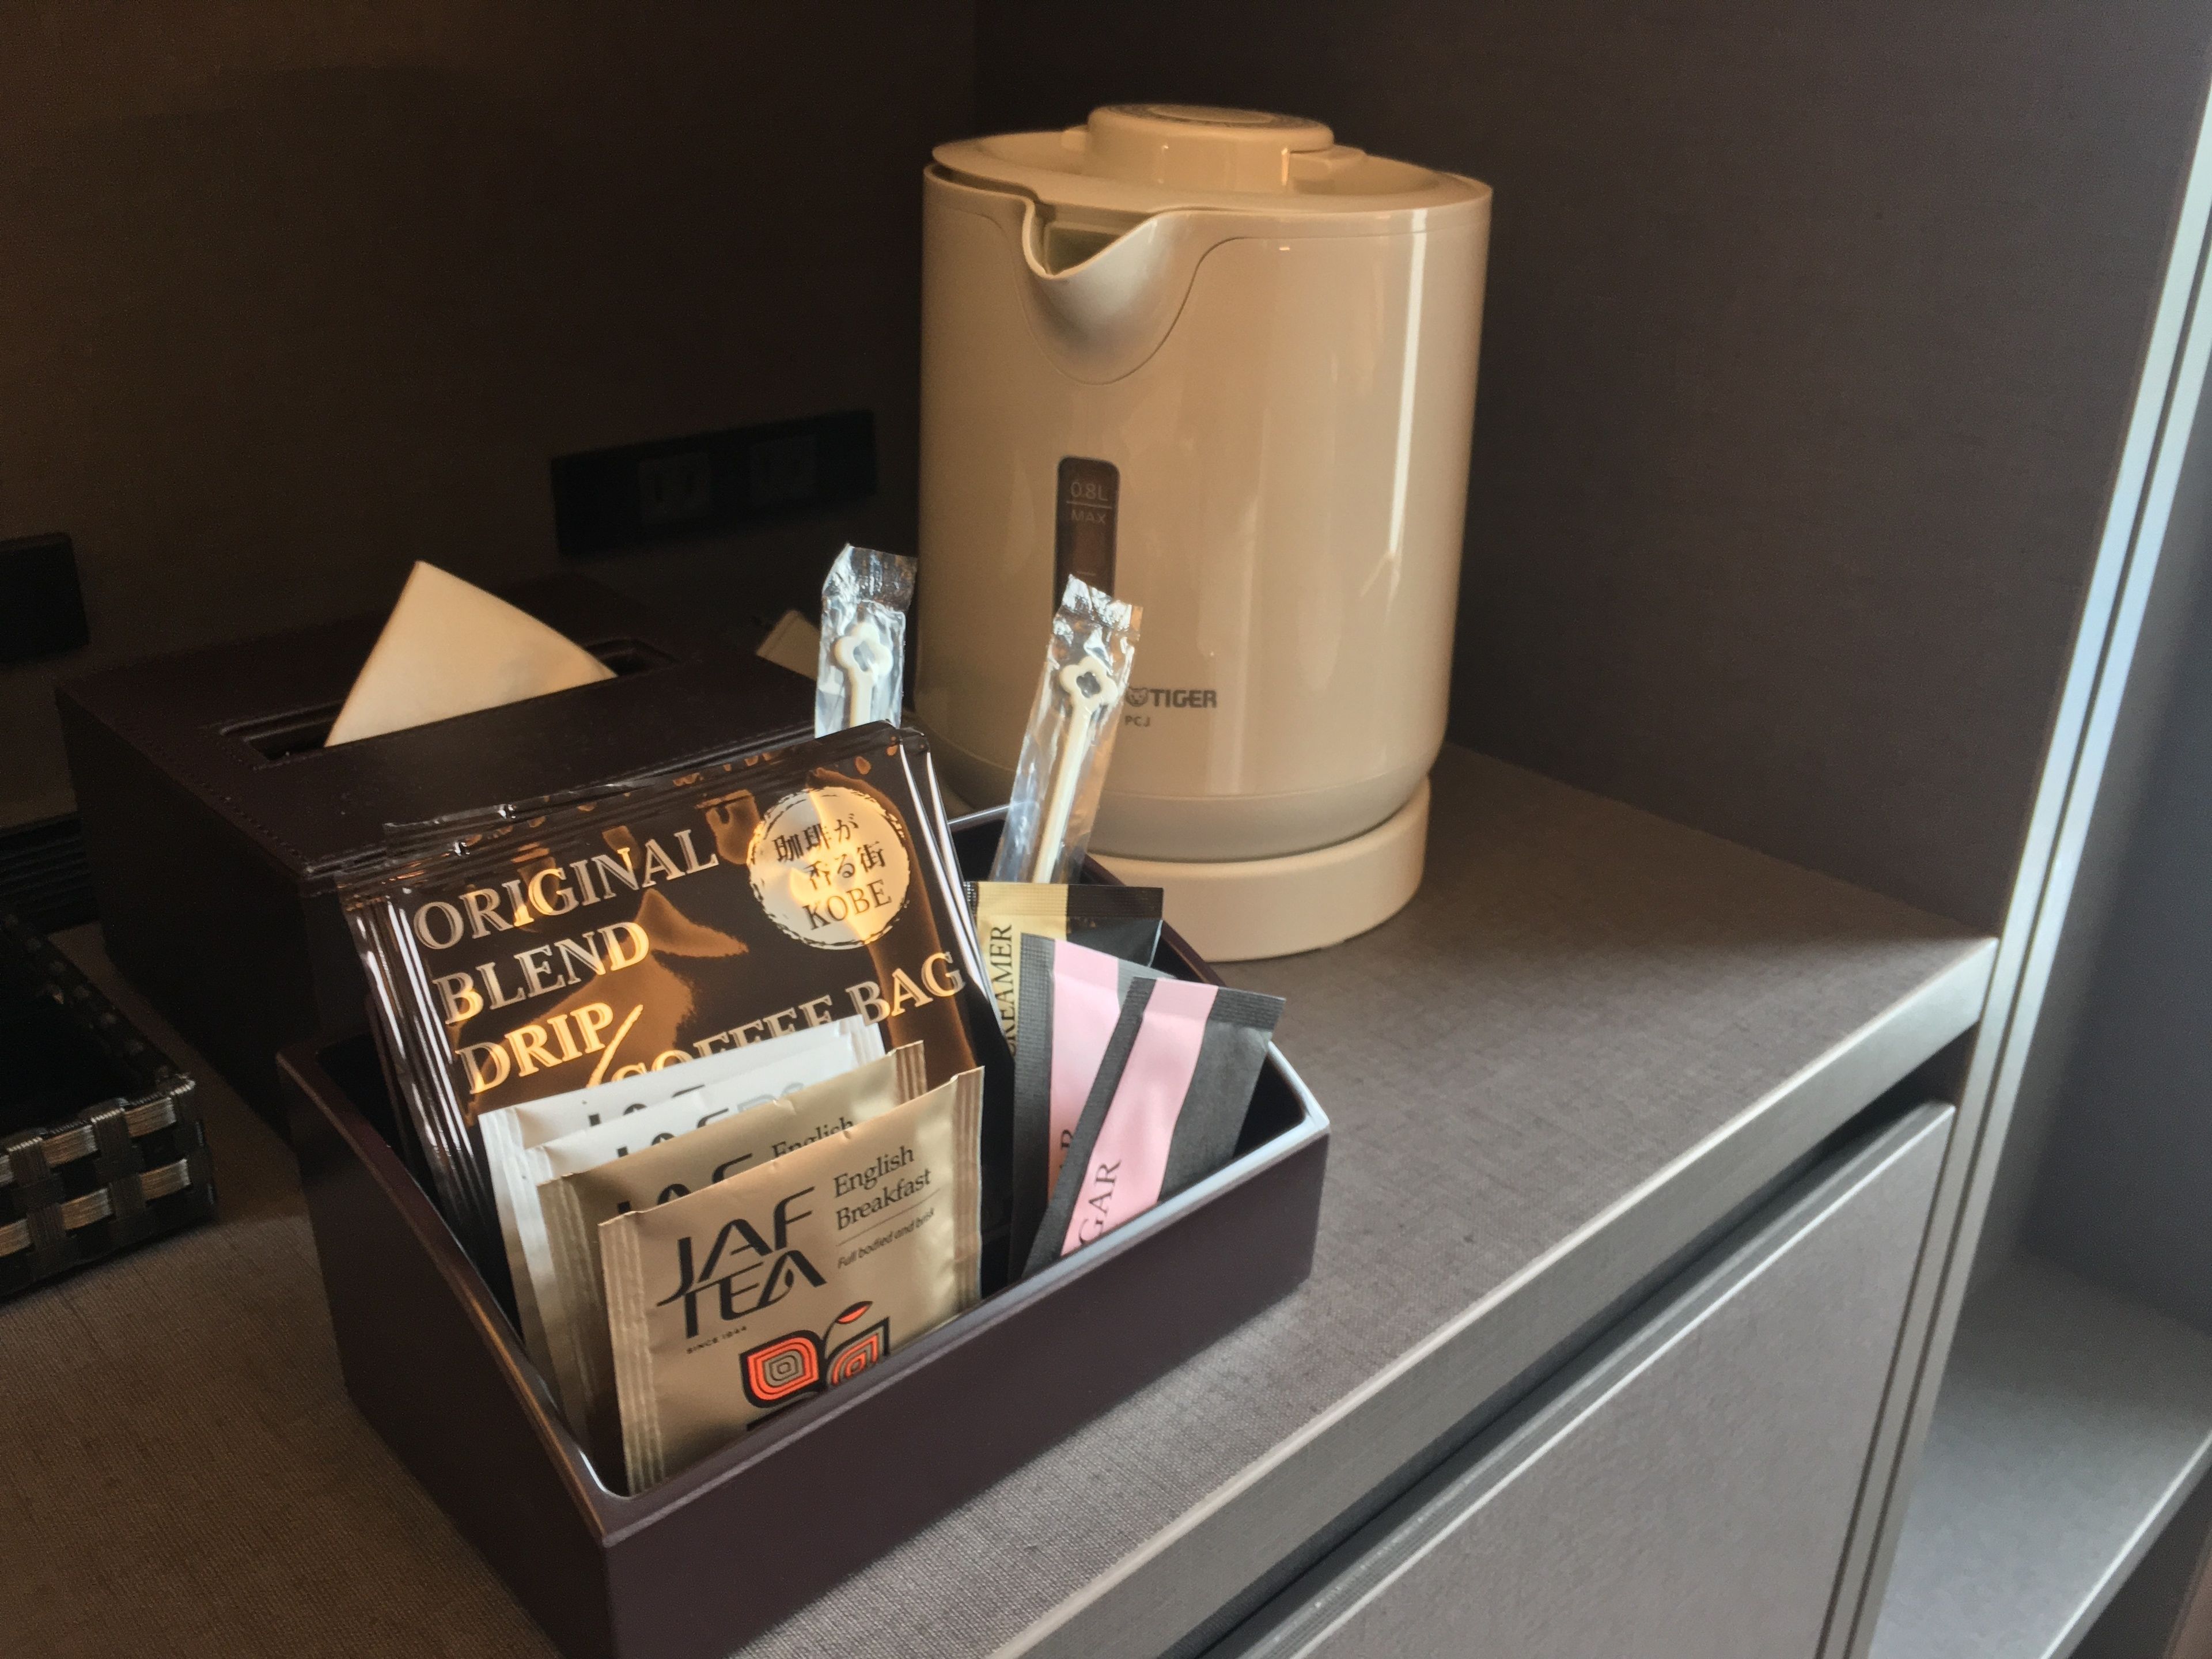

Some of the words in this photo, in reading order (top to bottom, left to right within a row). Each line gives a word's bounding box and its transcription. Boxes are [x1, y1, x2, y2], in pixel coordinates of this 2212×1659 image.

[1071, 509, 1106, 524] MAX
[1150, 688, 1218, 708] TIGER
[414, 828, 723, 950] ORIGINAL
[802, 879, 892, 930] KOBE
[432, 922, 650, 1025] BLEND
[844, 949, 967, 1027] BAG
[834, 1145, 915, 1198] English
[836, 1168, 931, 1230] Breakfast
[656, 1185, 815, 1307] JAF
[684, 1249, 828, 1339] TEA
